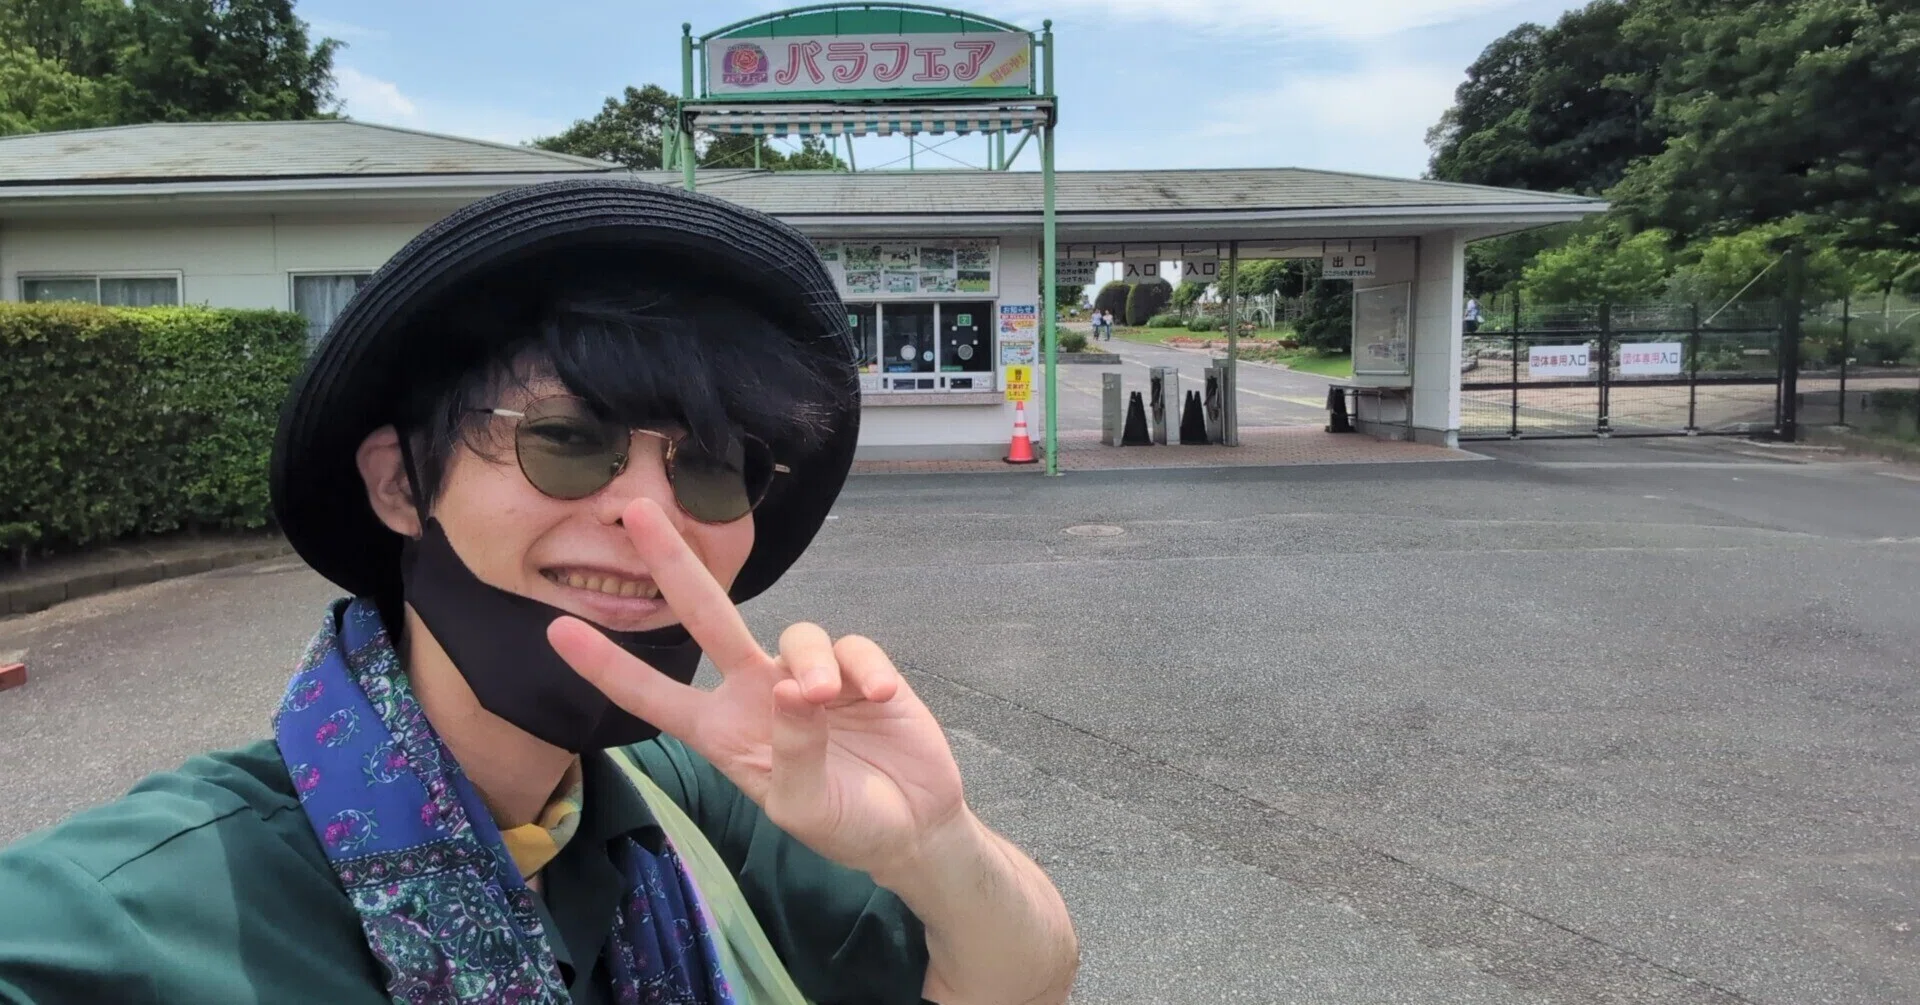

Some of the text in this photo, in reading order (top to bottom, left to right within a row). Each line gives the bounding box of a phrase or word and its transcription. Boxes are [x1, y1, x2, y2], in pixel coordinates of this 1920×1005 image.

[775, 40, 996, 86] バラフェア
[1332, 256, 1366, 268] 出口
[1127, 263, 1157, 277] 入口
[1185, 262, 1215, 276] 入口
[1531, 355, 1587, 367] 団体専用入口
[1623, 352, 1678, 365] 団体専用入口
